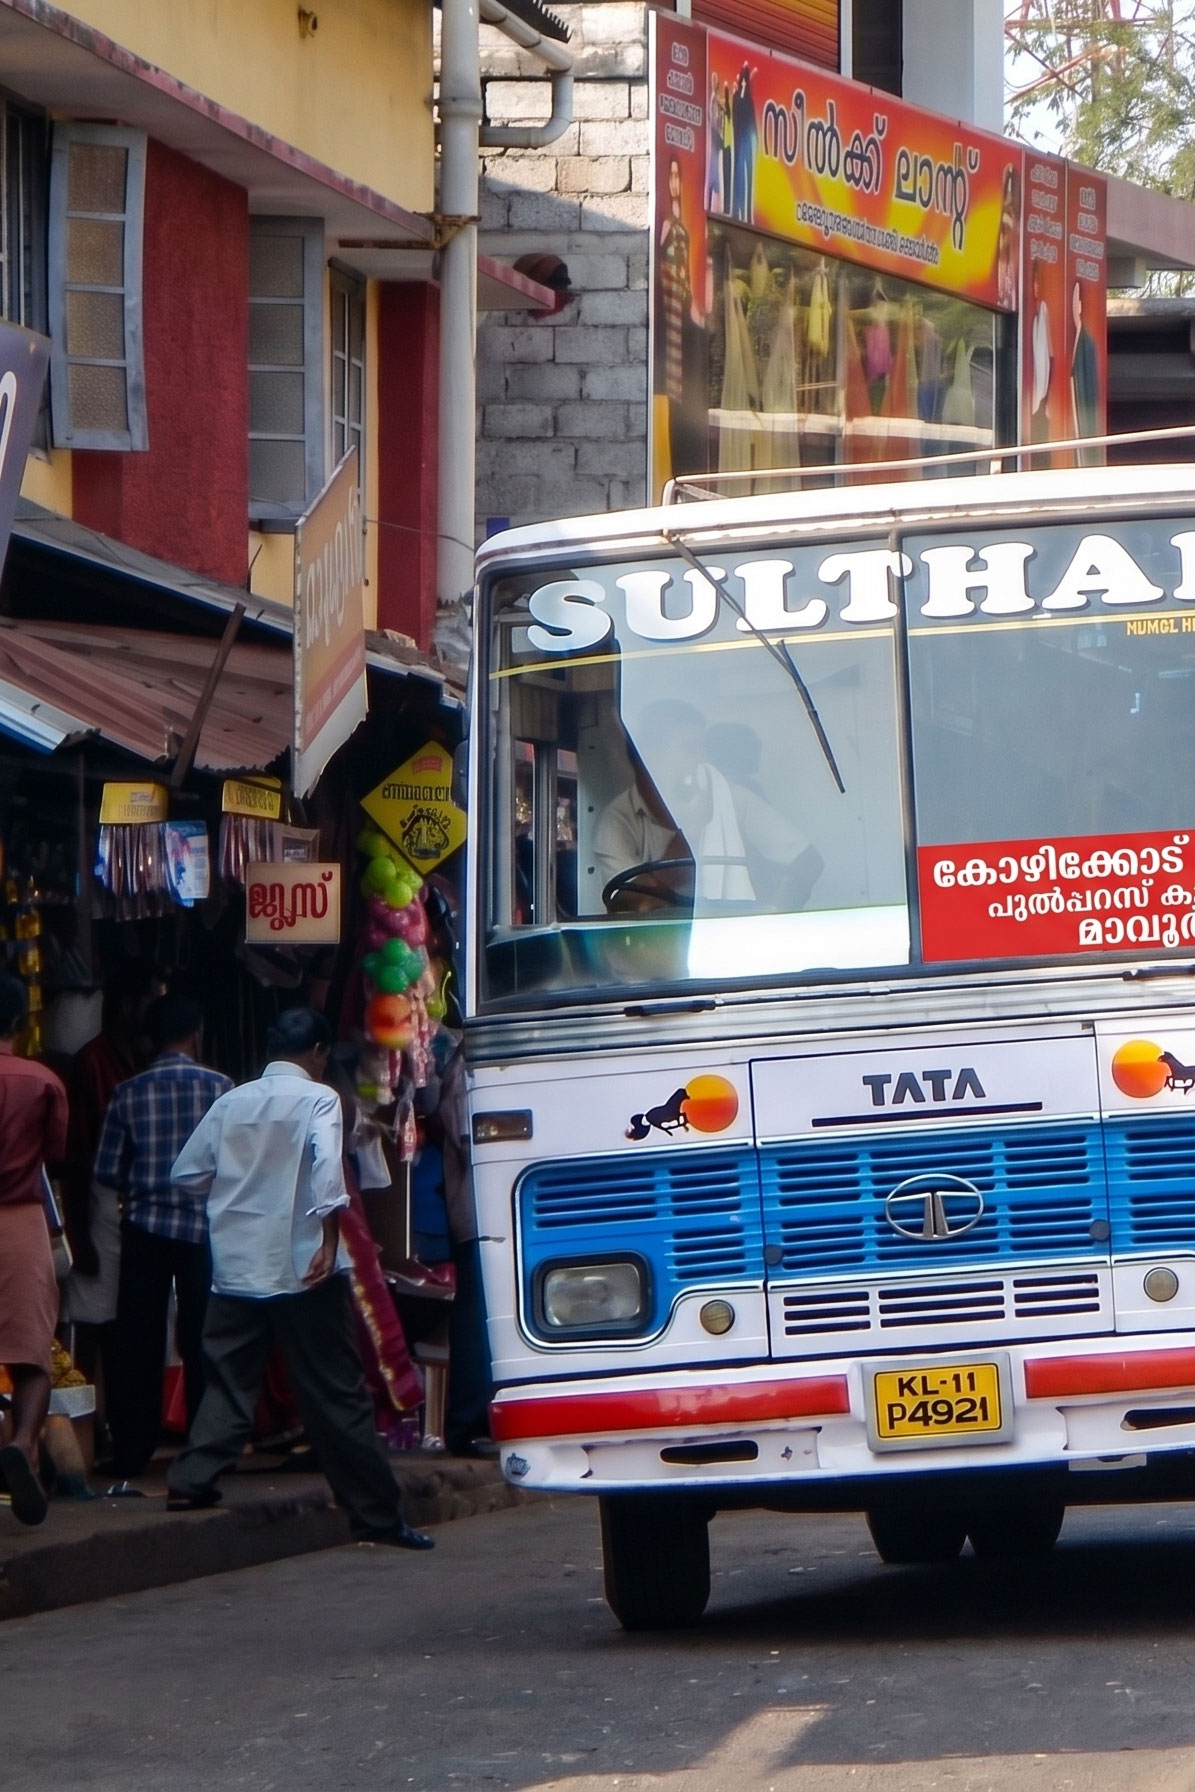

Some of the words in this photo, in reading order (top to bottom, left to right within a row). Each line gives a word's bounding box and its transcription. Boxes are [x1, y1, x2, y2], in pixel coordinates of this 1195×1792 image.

[933, 834, 1191, 888] കോഴിക്കോട്
[862, 1067, 987, 1107] TATA
[897, 1371, 976, 1398] KL-11
[886, 1396, 989, 1431] P4921
